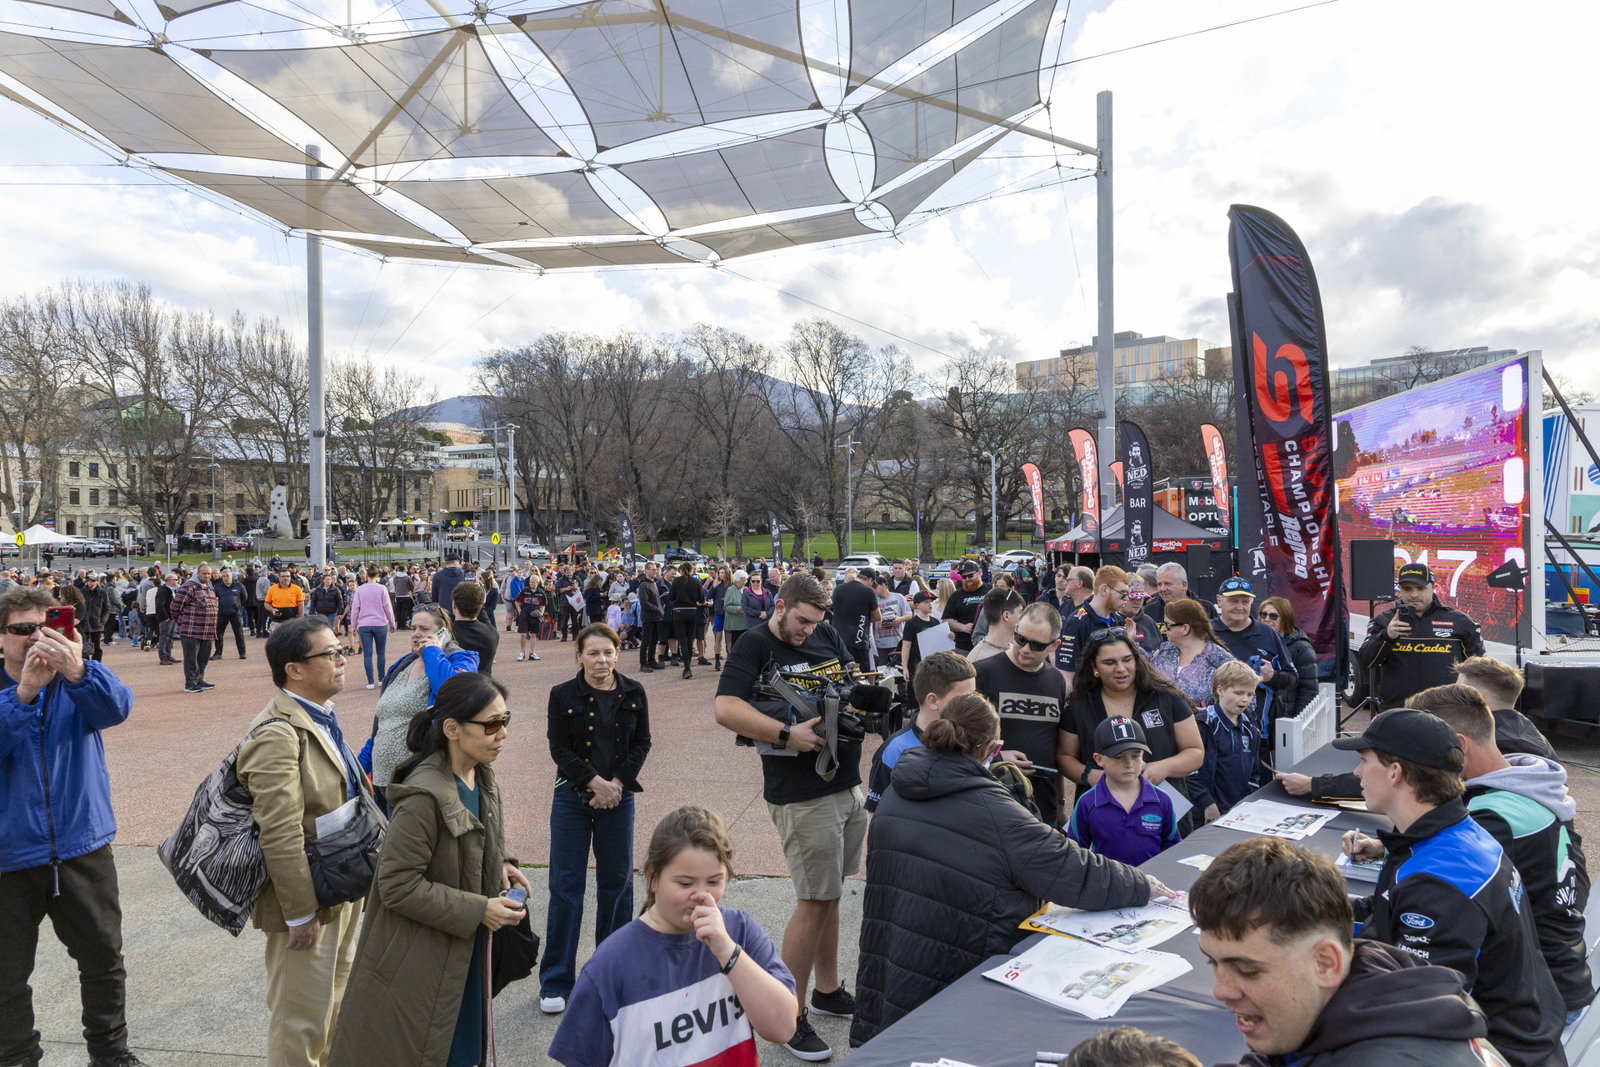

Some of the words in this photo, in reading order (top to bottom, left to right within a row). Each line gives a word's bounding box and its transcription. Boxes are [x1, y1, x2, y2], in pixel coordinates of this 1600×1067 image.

[1127, 468, 1148, 482] NED
[1129, 498, 1146, 508] BAR
[1188, 512, 1219, 521] OPTU
[1128, 547, 1148, 558] NED
[1279, 513, 1308, 579] Repco
[855, 615, 866, 643] RVCA
[1413, 643, 1452, 653] Cadet
[1001, 698, 1059, 718] astars
[1119, 725, 1128, 738] 1
